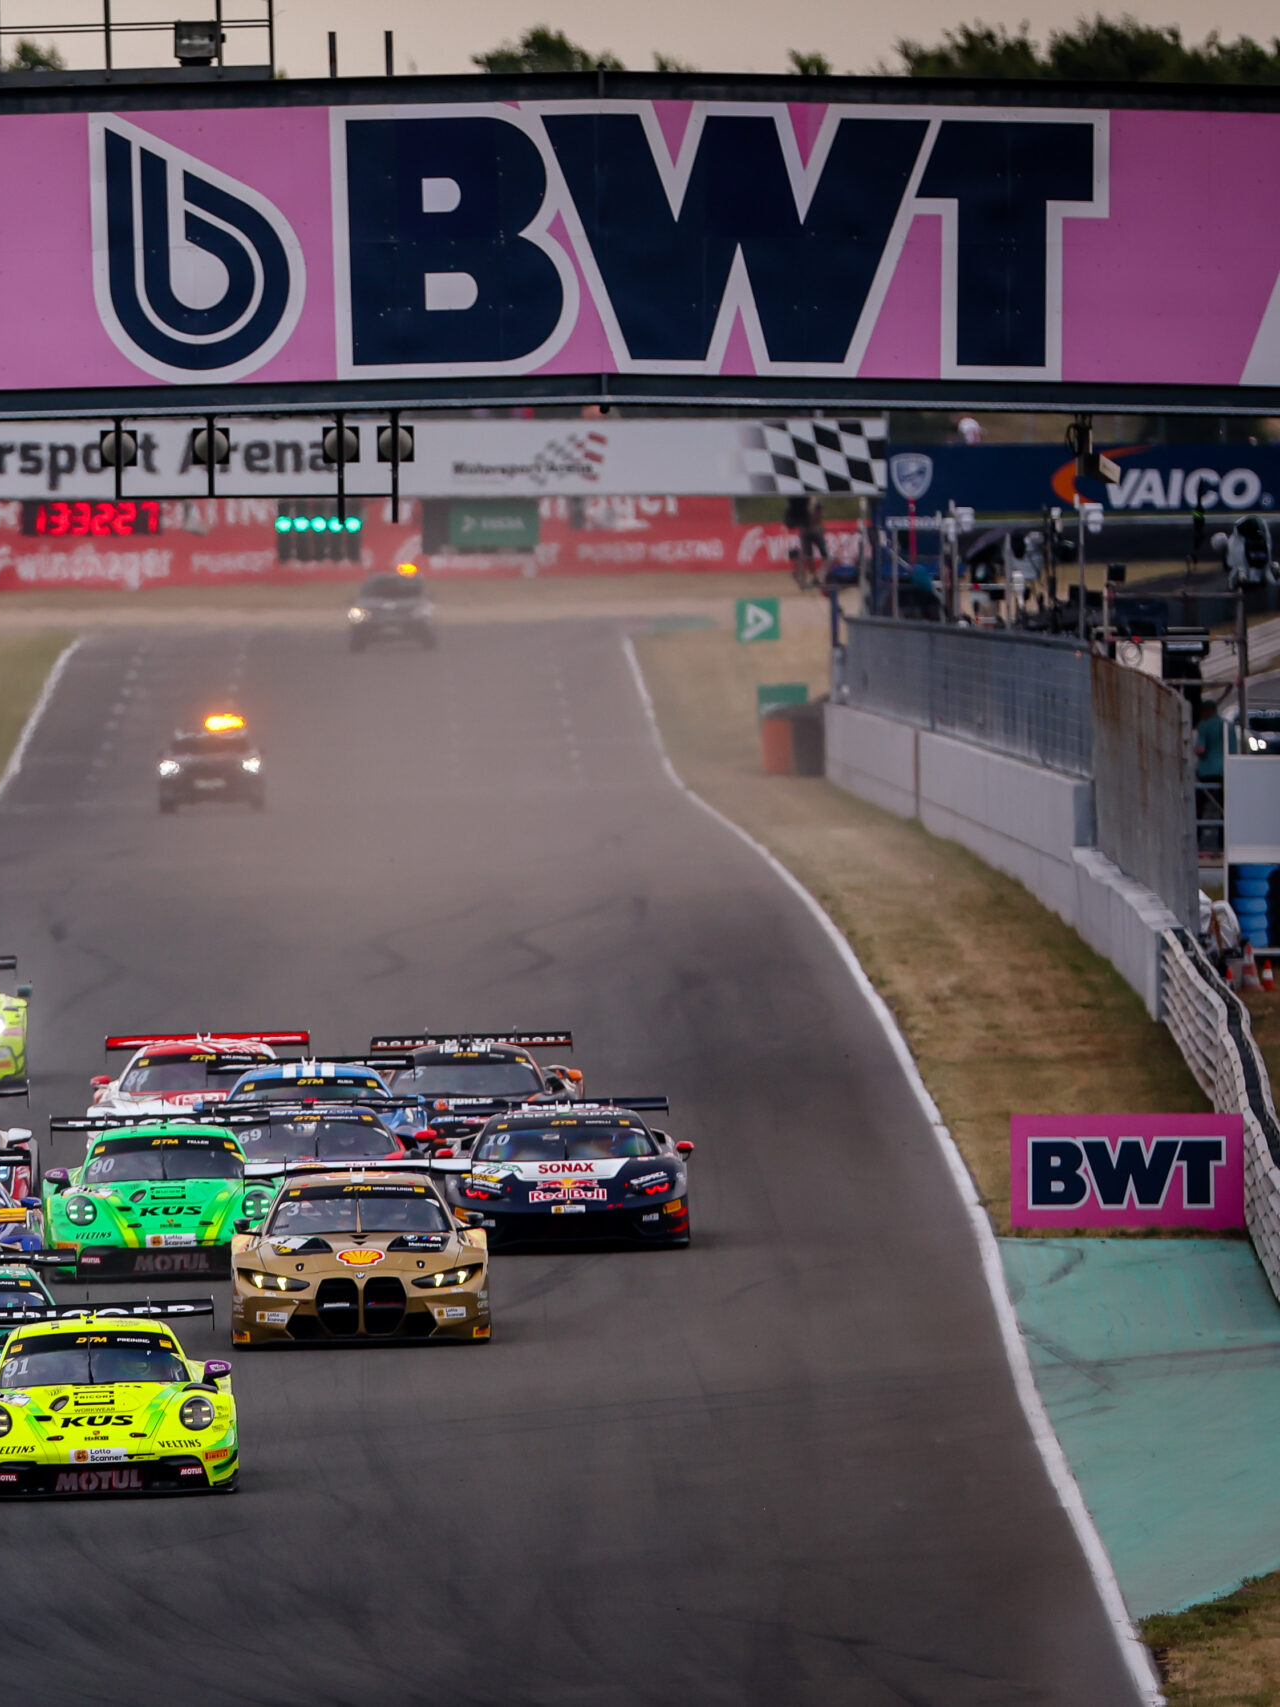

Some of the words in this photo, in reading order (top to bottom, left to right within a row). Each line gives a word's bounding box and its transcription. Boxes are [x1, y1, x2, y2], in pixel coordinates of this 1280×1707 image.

[334, 103, 1108, 379] BWT
[1107, 467, 1261, 509] VAICO
[238, 1128, 263, 1145] 69
[486, 1133, 511, 1146] 10
[89, 1158, 116, 1176] 90
[538, 1162, 594, 1174] SONAX
[1027, 1136, 1227, 1210] BWT
[529, 1188, 568, 1203] Red
[569, 1188, 608, 1201] Bull
[139, 1205, 203, 1217] KÜS
[286, 1202, 301, 1217] 3
[75, 1231, 112, 1240] VELTINS
[133, 1253, 210, 1272] MOTUL
[3, 1357, 30, 1378] 91
[60, 1414, 134, 1429] KÜS
[157, 1438, 202, 1449] VELTINS
[90, 1448, 112, 1456] Lotto
[90, 1454, 122, 1462] Scanner
[204, 1449, 228, 1461] PIRELLI
[180, 1467, 203, 1475] MOTUL
[54, 1468, 143, 1492] MOTUL
